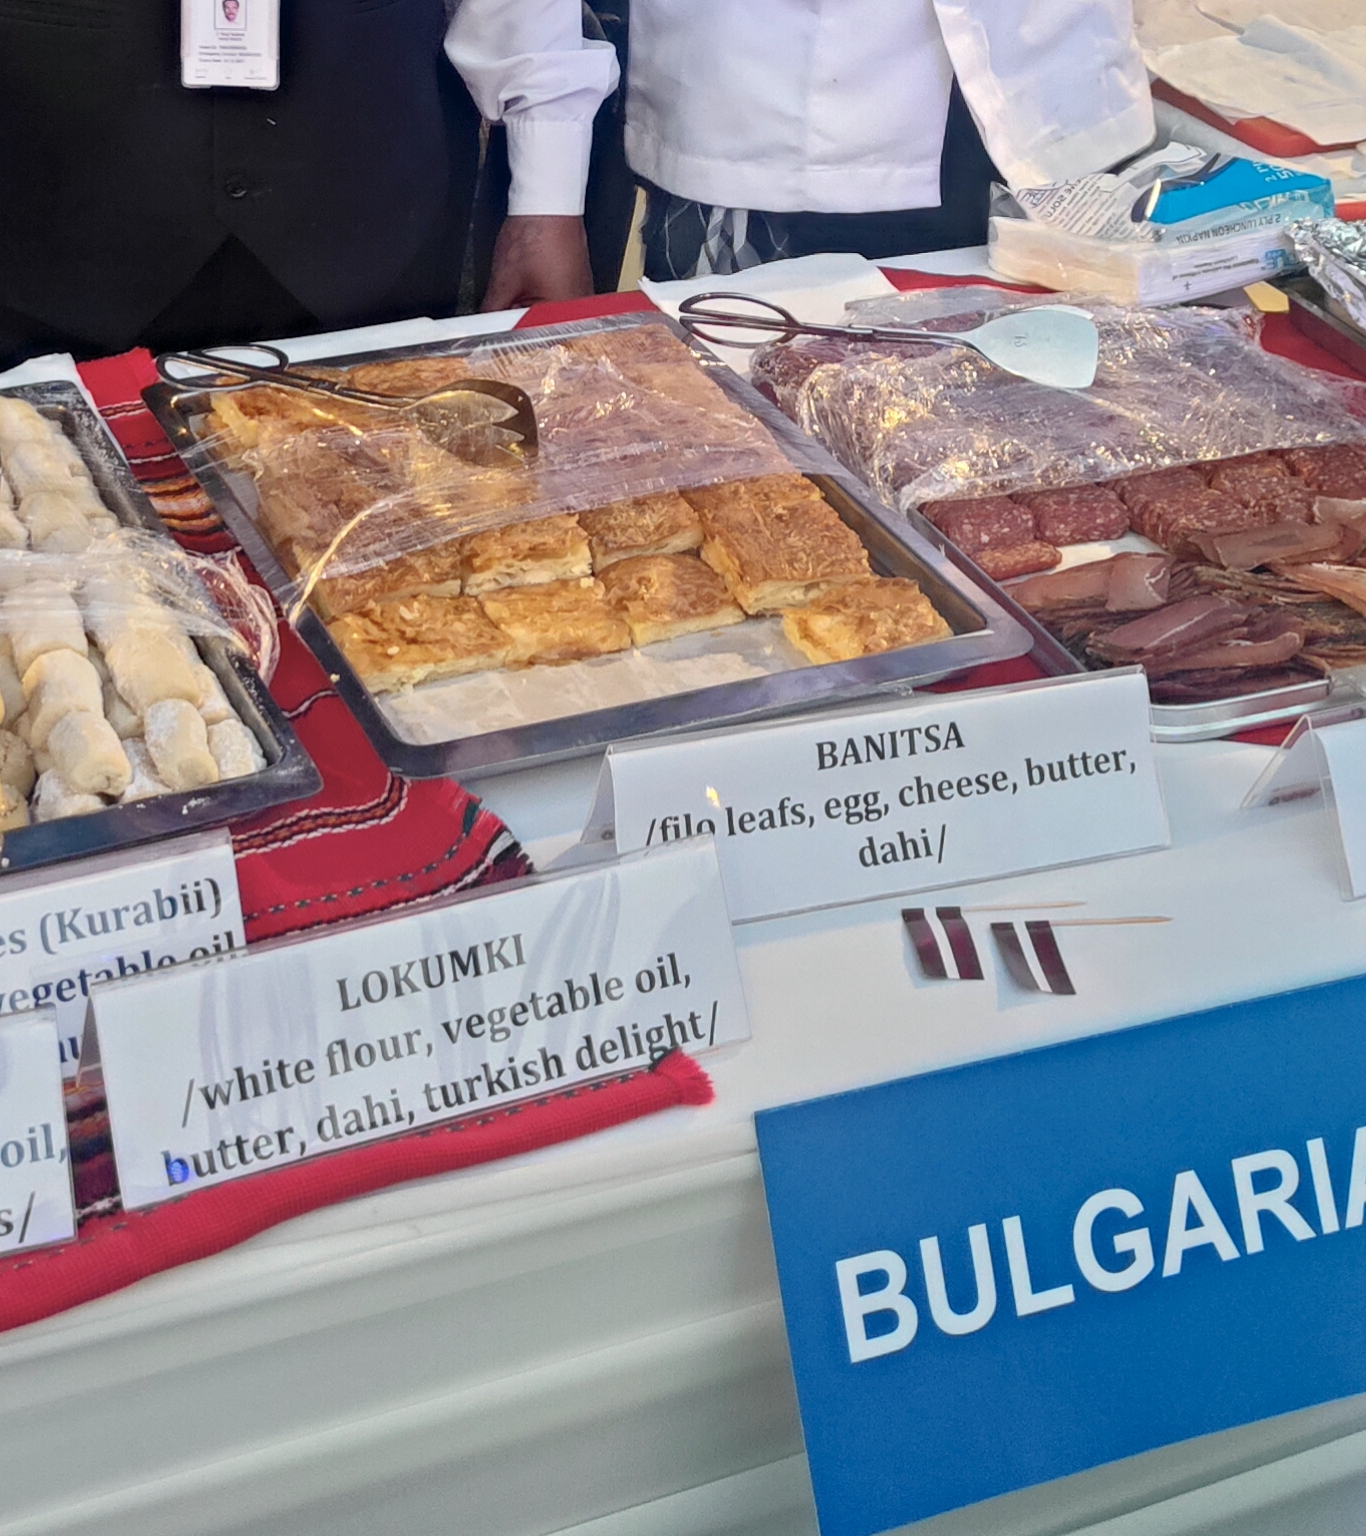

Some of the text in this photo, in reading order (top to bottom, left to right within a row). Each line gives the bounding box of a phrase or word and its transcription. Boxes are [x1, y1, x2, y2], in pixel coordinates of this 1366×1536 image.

[1211, 217, 1256, 239] LUNCHEON
[1257, 215, 1273, 227] PLY
[1274, 214, 1281, 223] 2
[815, 720, 965, 771] BANITSA
[726, 796, 815, 837] leafs,
[824, 787, 890, 825] egg,
[899, 767, 1018, 809] cheese,
[1024, 747, 1137, 787] butter,
[858, 824, 947, 868] dahi/
[39, 876, 224, 955] (Kurabii)
[336, 933, 528, 1012] LOKUMKI
[182, 951, 693, 1127] /white flour, vegetable oil,
[161, 1000, 720, 1187] butter, dahi, turkish delight/
[0, 1122, 67, 1169] oil,
